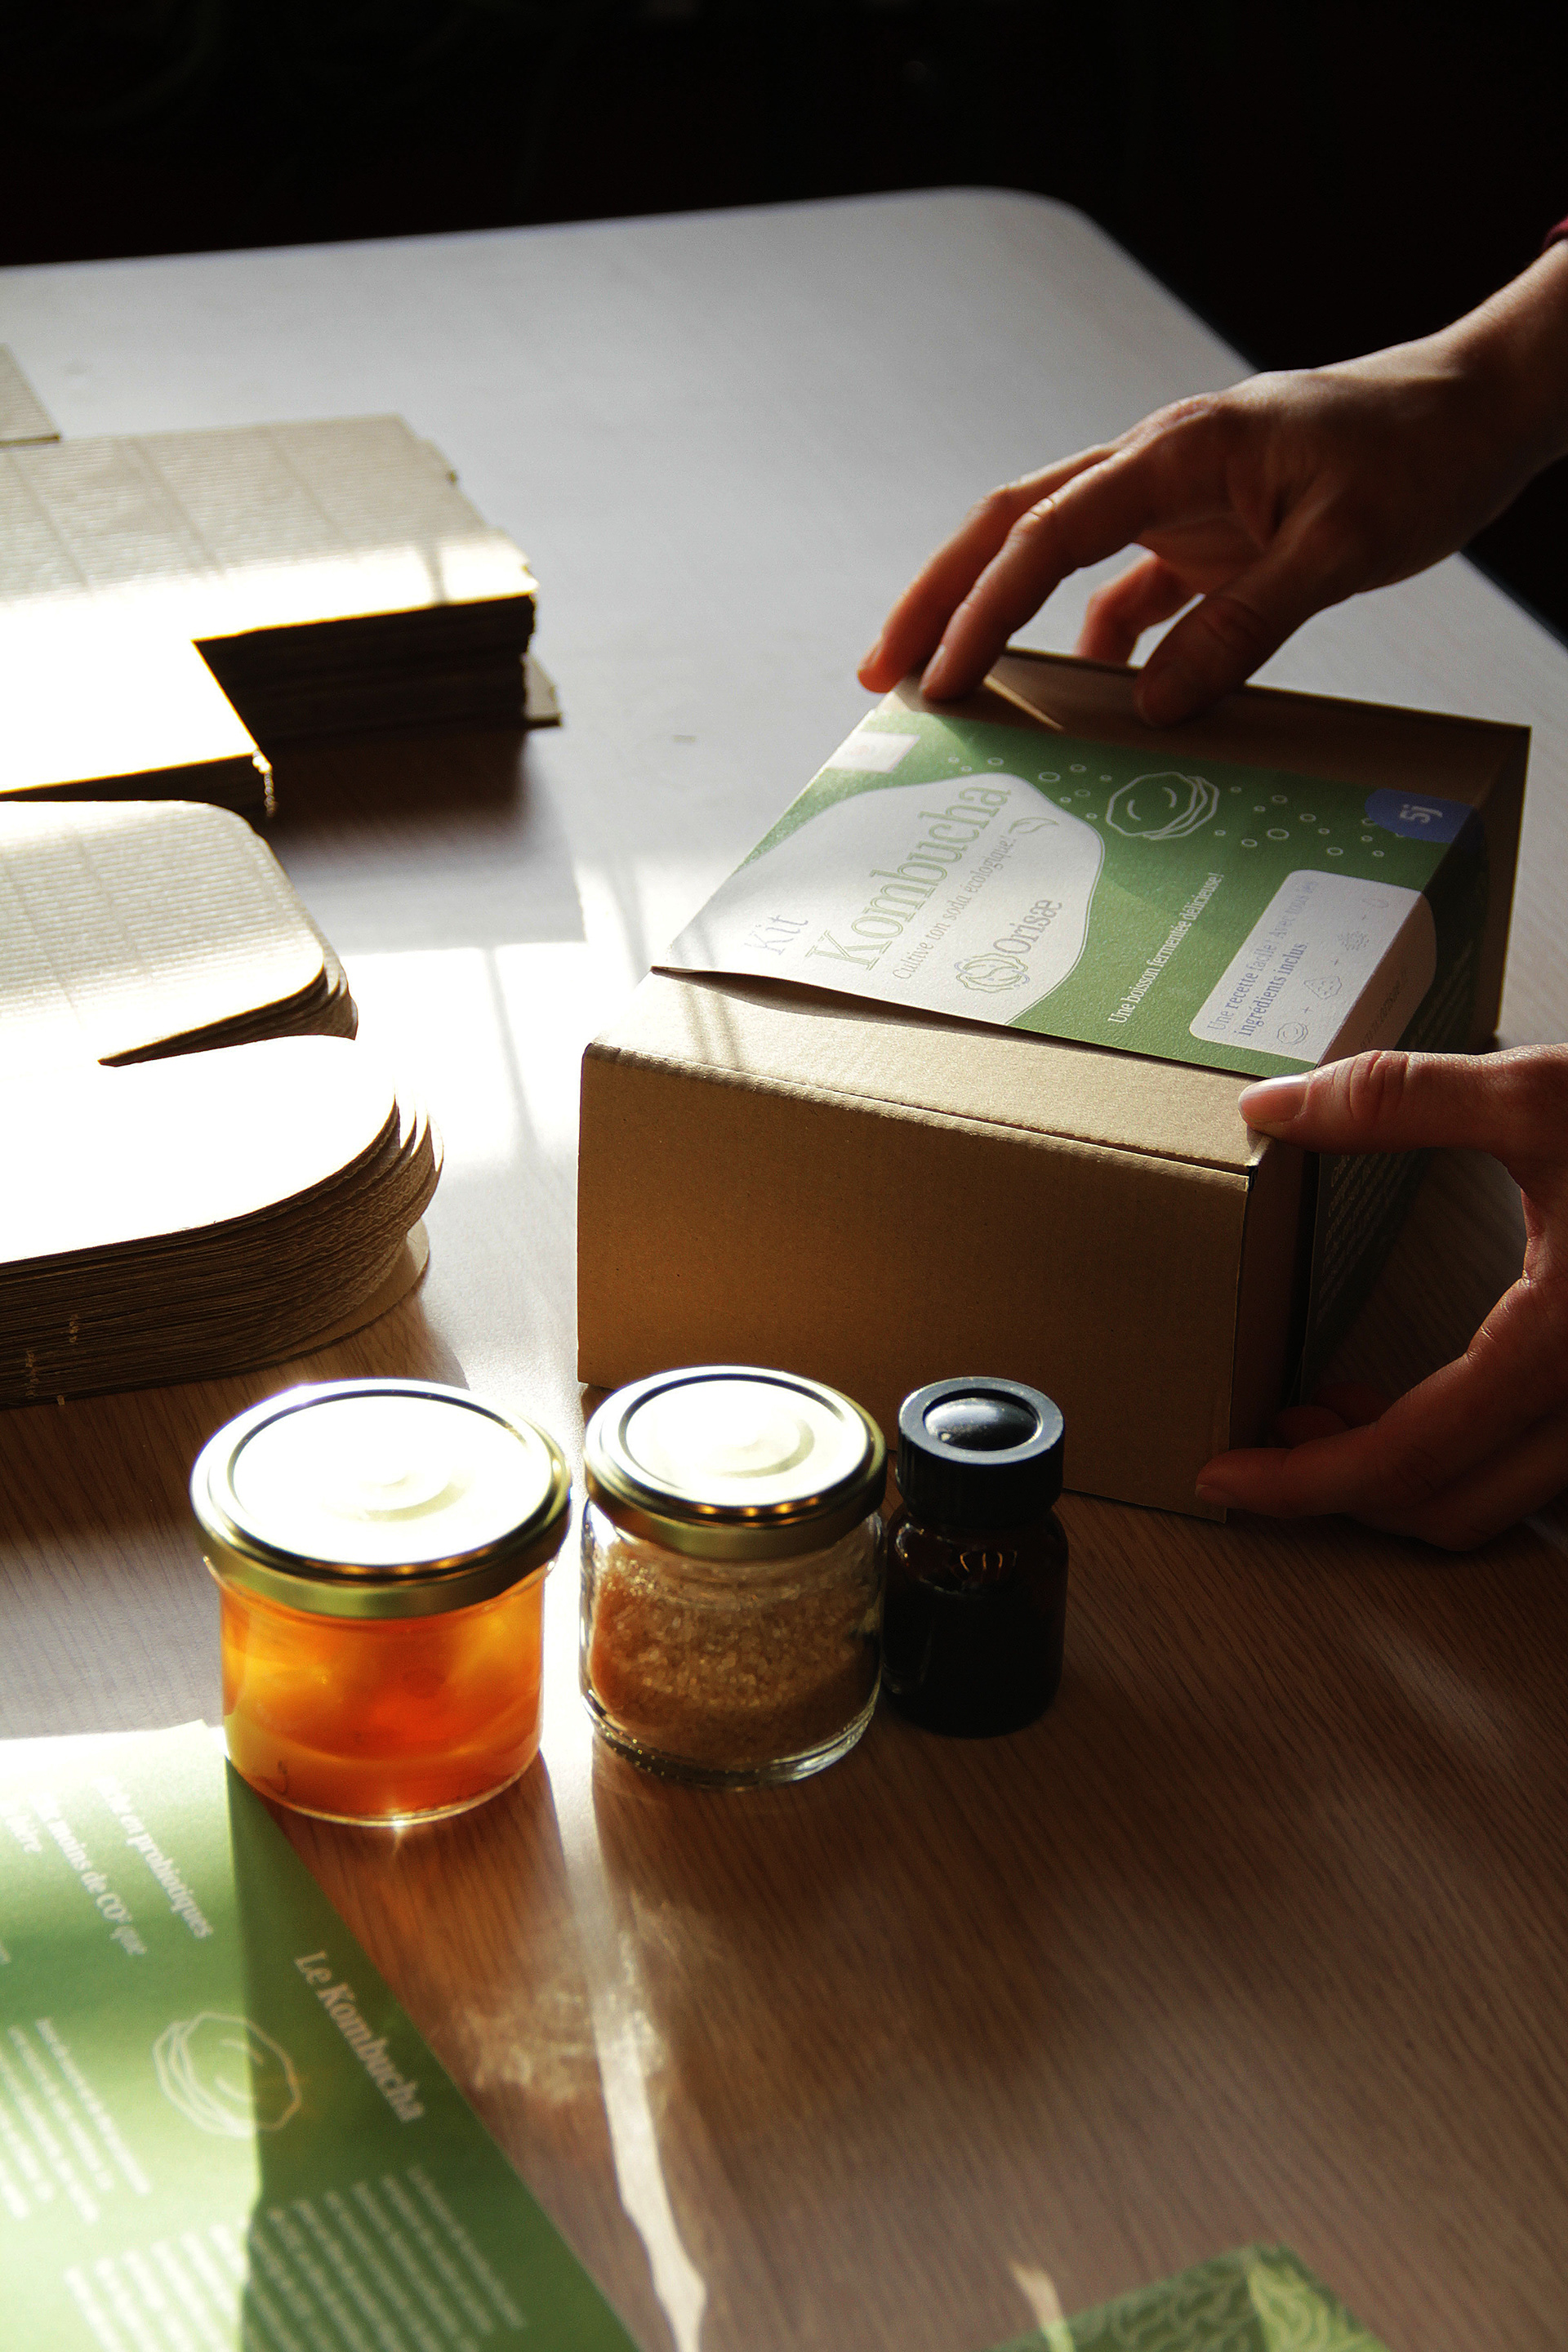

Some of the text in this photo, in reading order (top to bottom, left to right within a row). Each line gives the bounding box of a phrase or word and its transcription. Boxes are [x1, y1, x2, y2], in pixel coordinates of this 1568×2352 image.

[1400, 804, 1443, 824] 5j
[804, 786, 1012, 971] Kombucha
[744, 915, 808, 956] Kit
[893, 941, 934, 979] Cultive
[925, 922, 951, 940] ton
[942, 894, 973, 921] soda
[1146, 919, 1192, 968] fermentée
[1120, 965, 1161, 1004] boisson
[1207, 1009, 1234, 1031] Une
[1225, 972, 1259, 1010] recette
[1234, 976, 1287, 1037] ingrédients
[1107, 1002, 1136, 1023] Une
[294, 1949, 425, 2123] Le Kombucha
